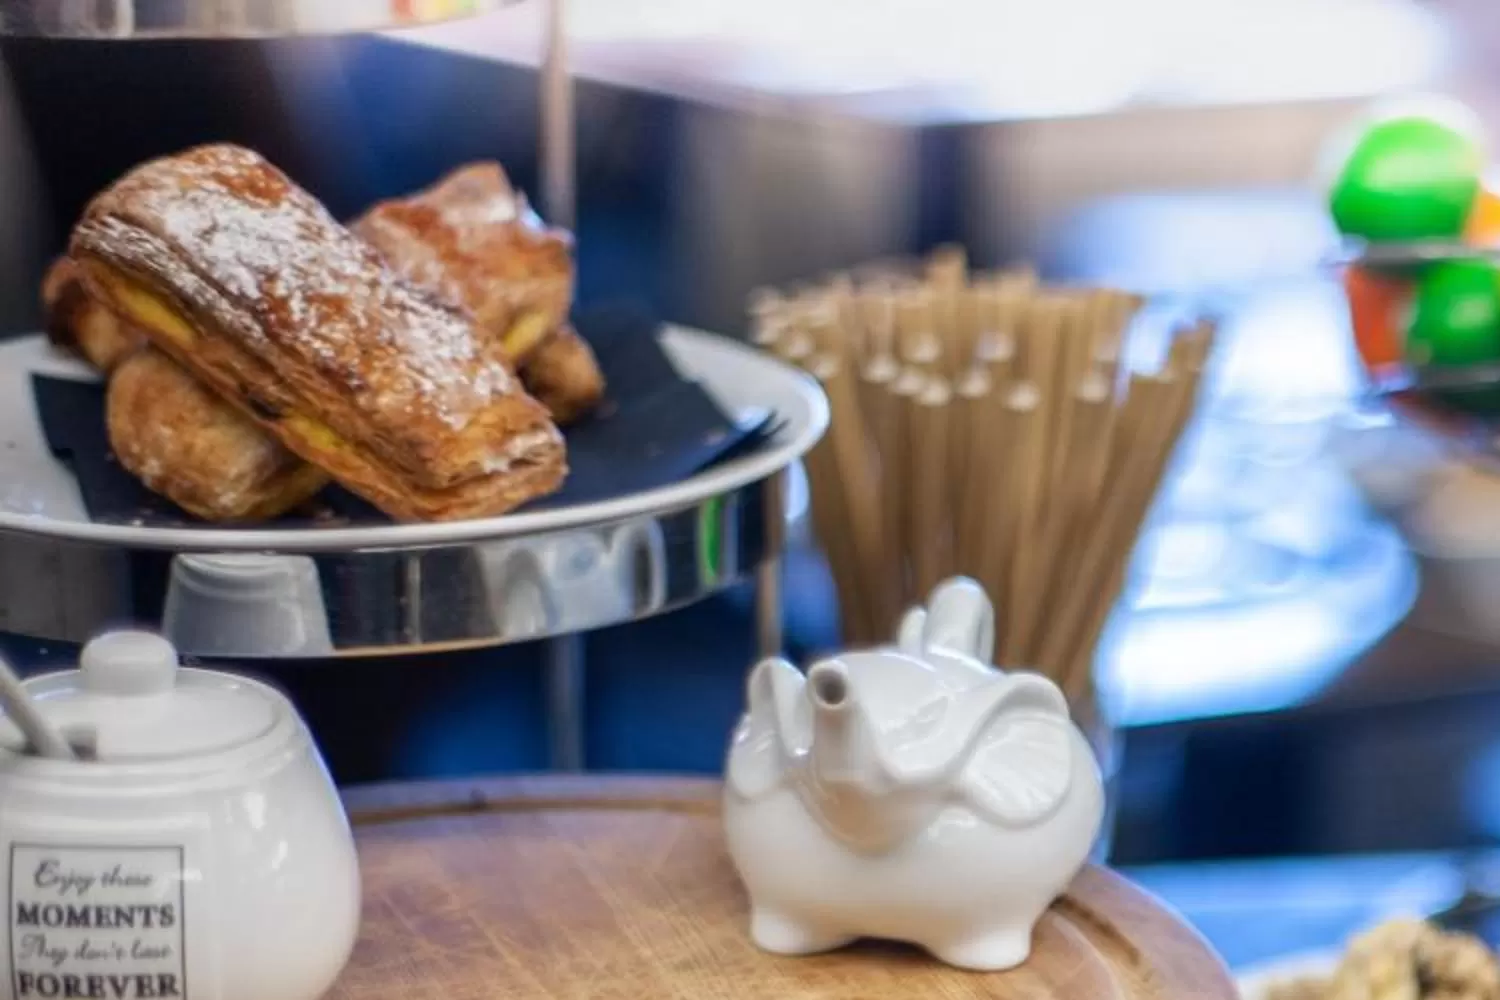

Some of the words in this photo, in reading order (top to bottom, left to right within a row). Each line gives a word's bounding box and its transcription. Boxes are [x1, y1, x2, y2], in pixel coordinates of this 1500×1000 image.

[33, 858, 95, 896] Enjoy
[16, 901, 176, 929] MOMENTS
[18, 933, 68, 968] They
[18, 971, 181, 1000] FOREVER
